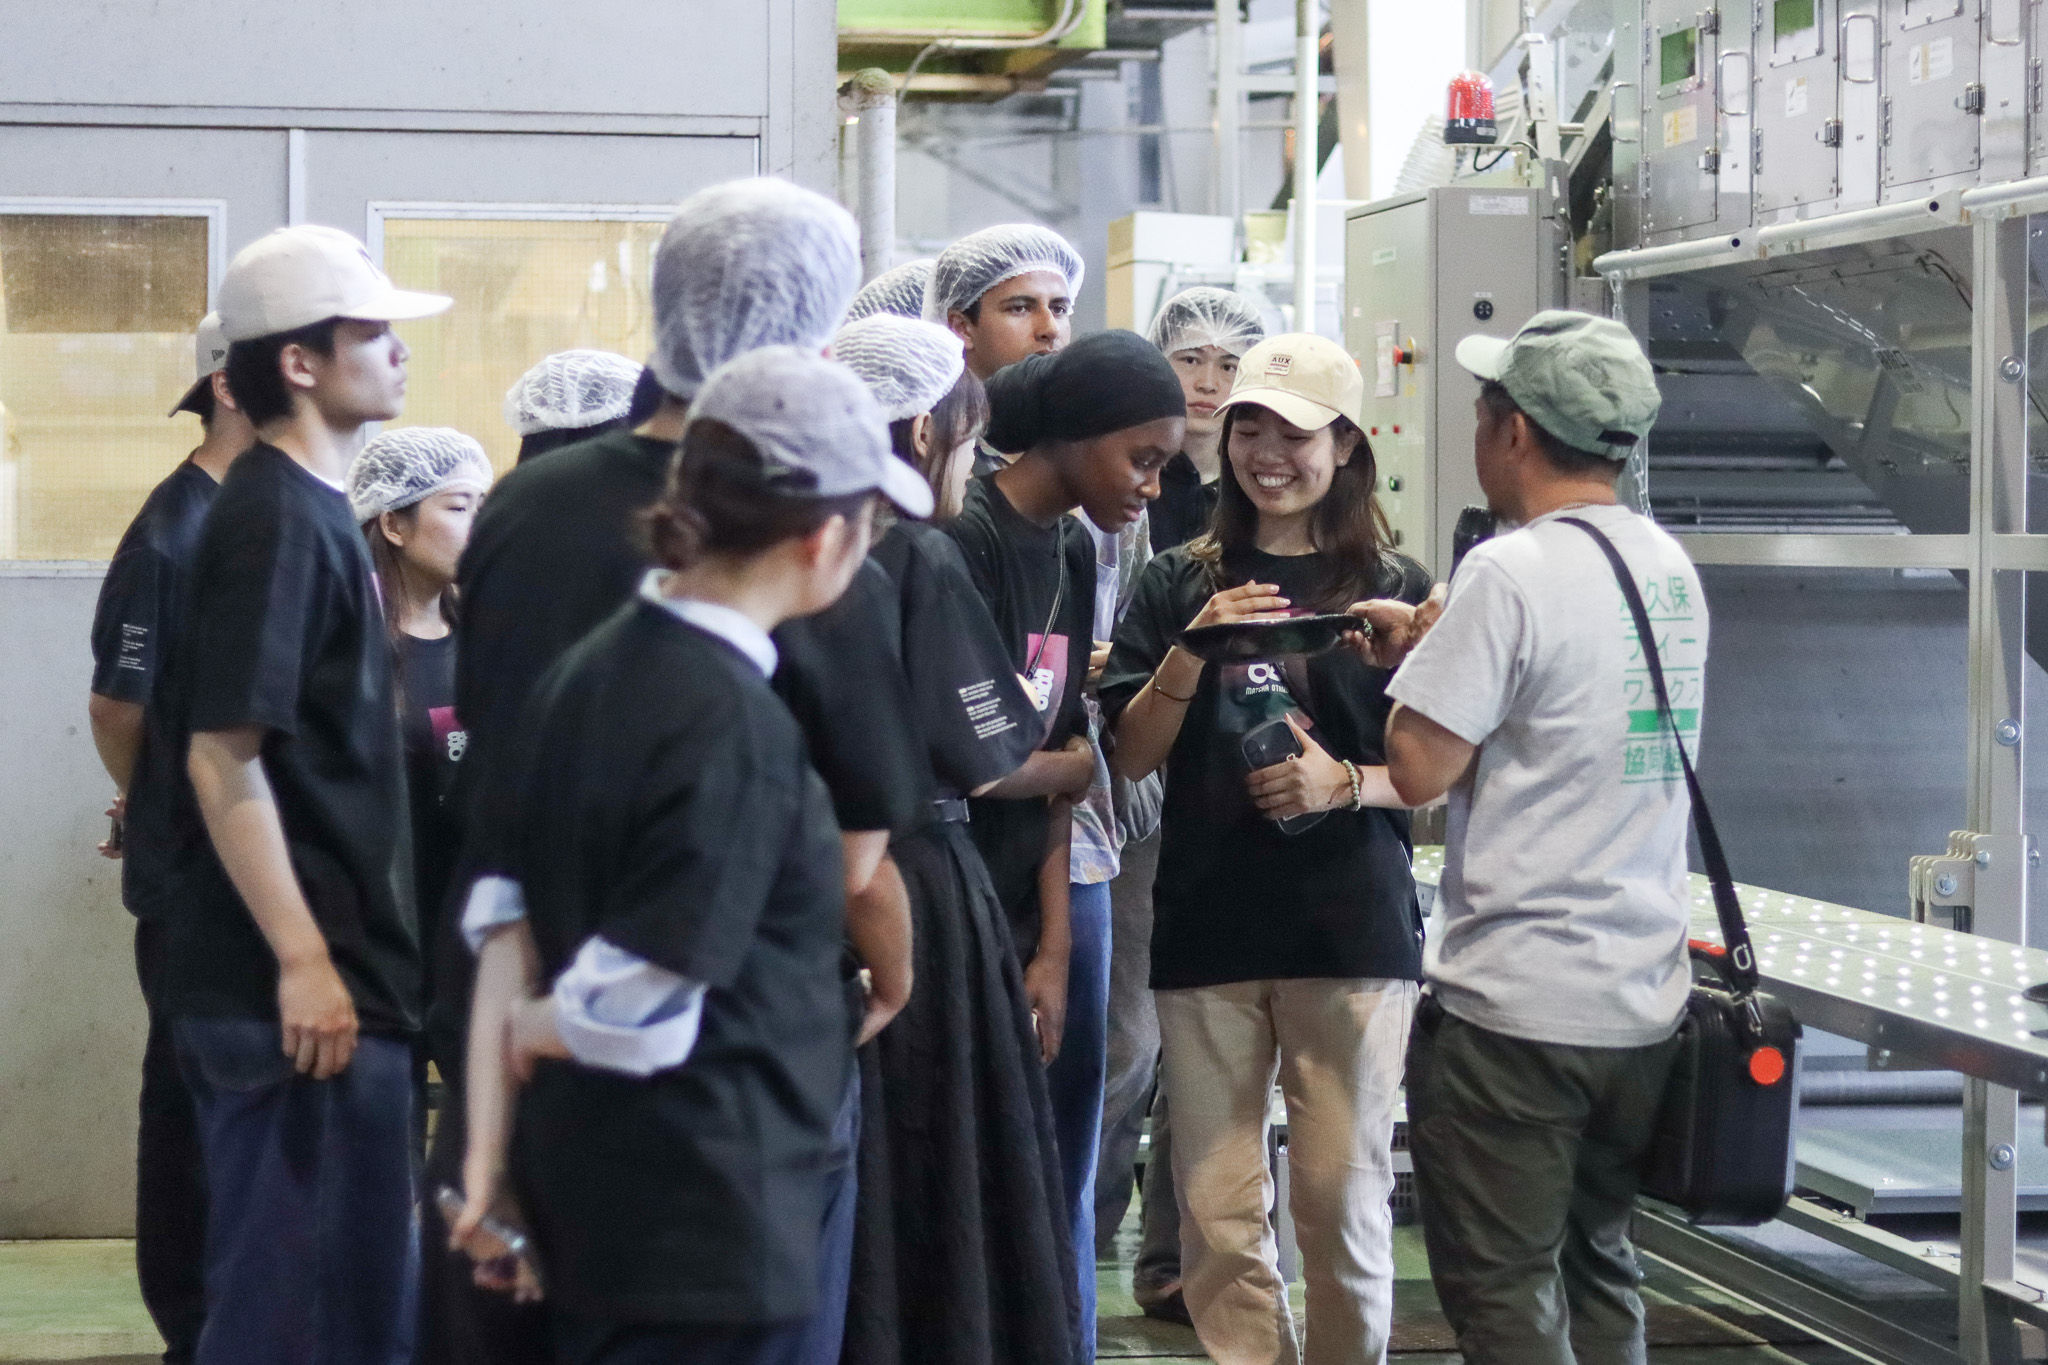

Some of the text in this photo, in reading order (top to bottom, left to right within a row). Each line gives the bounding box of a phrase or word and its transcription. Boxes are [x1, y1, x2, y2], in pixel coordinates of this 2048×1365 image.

[1271, 356, 1291, 365] AUX
[1623, 677, 1699, 706] ワクス
